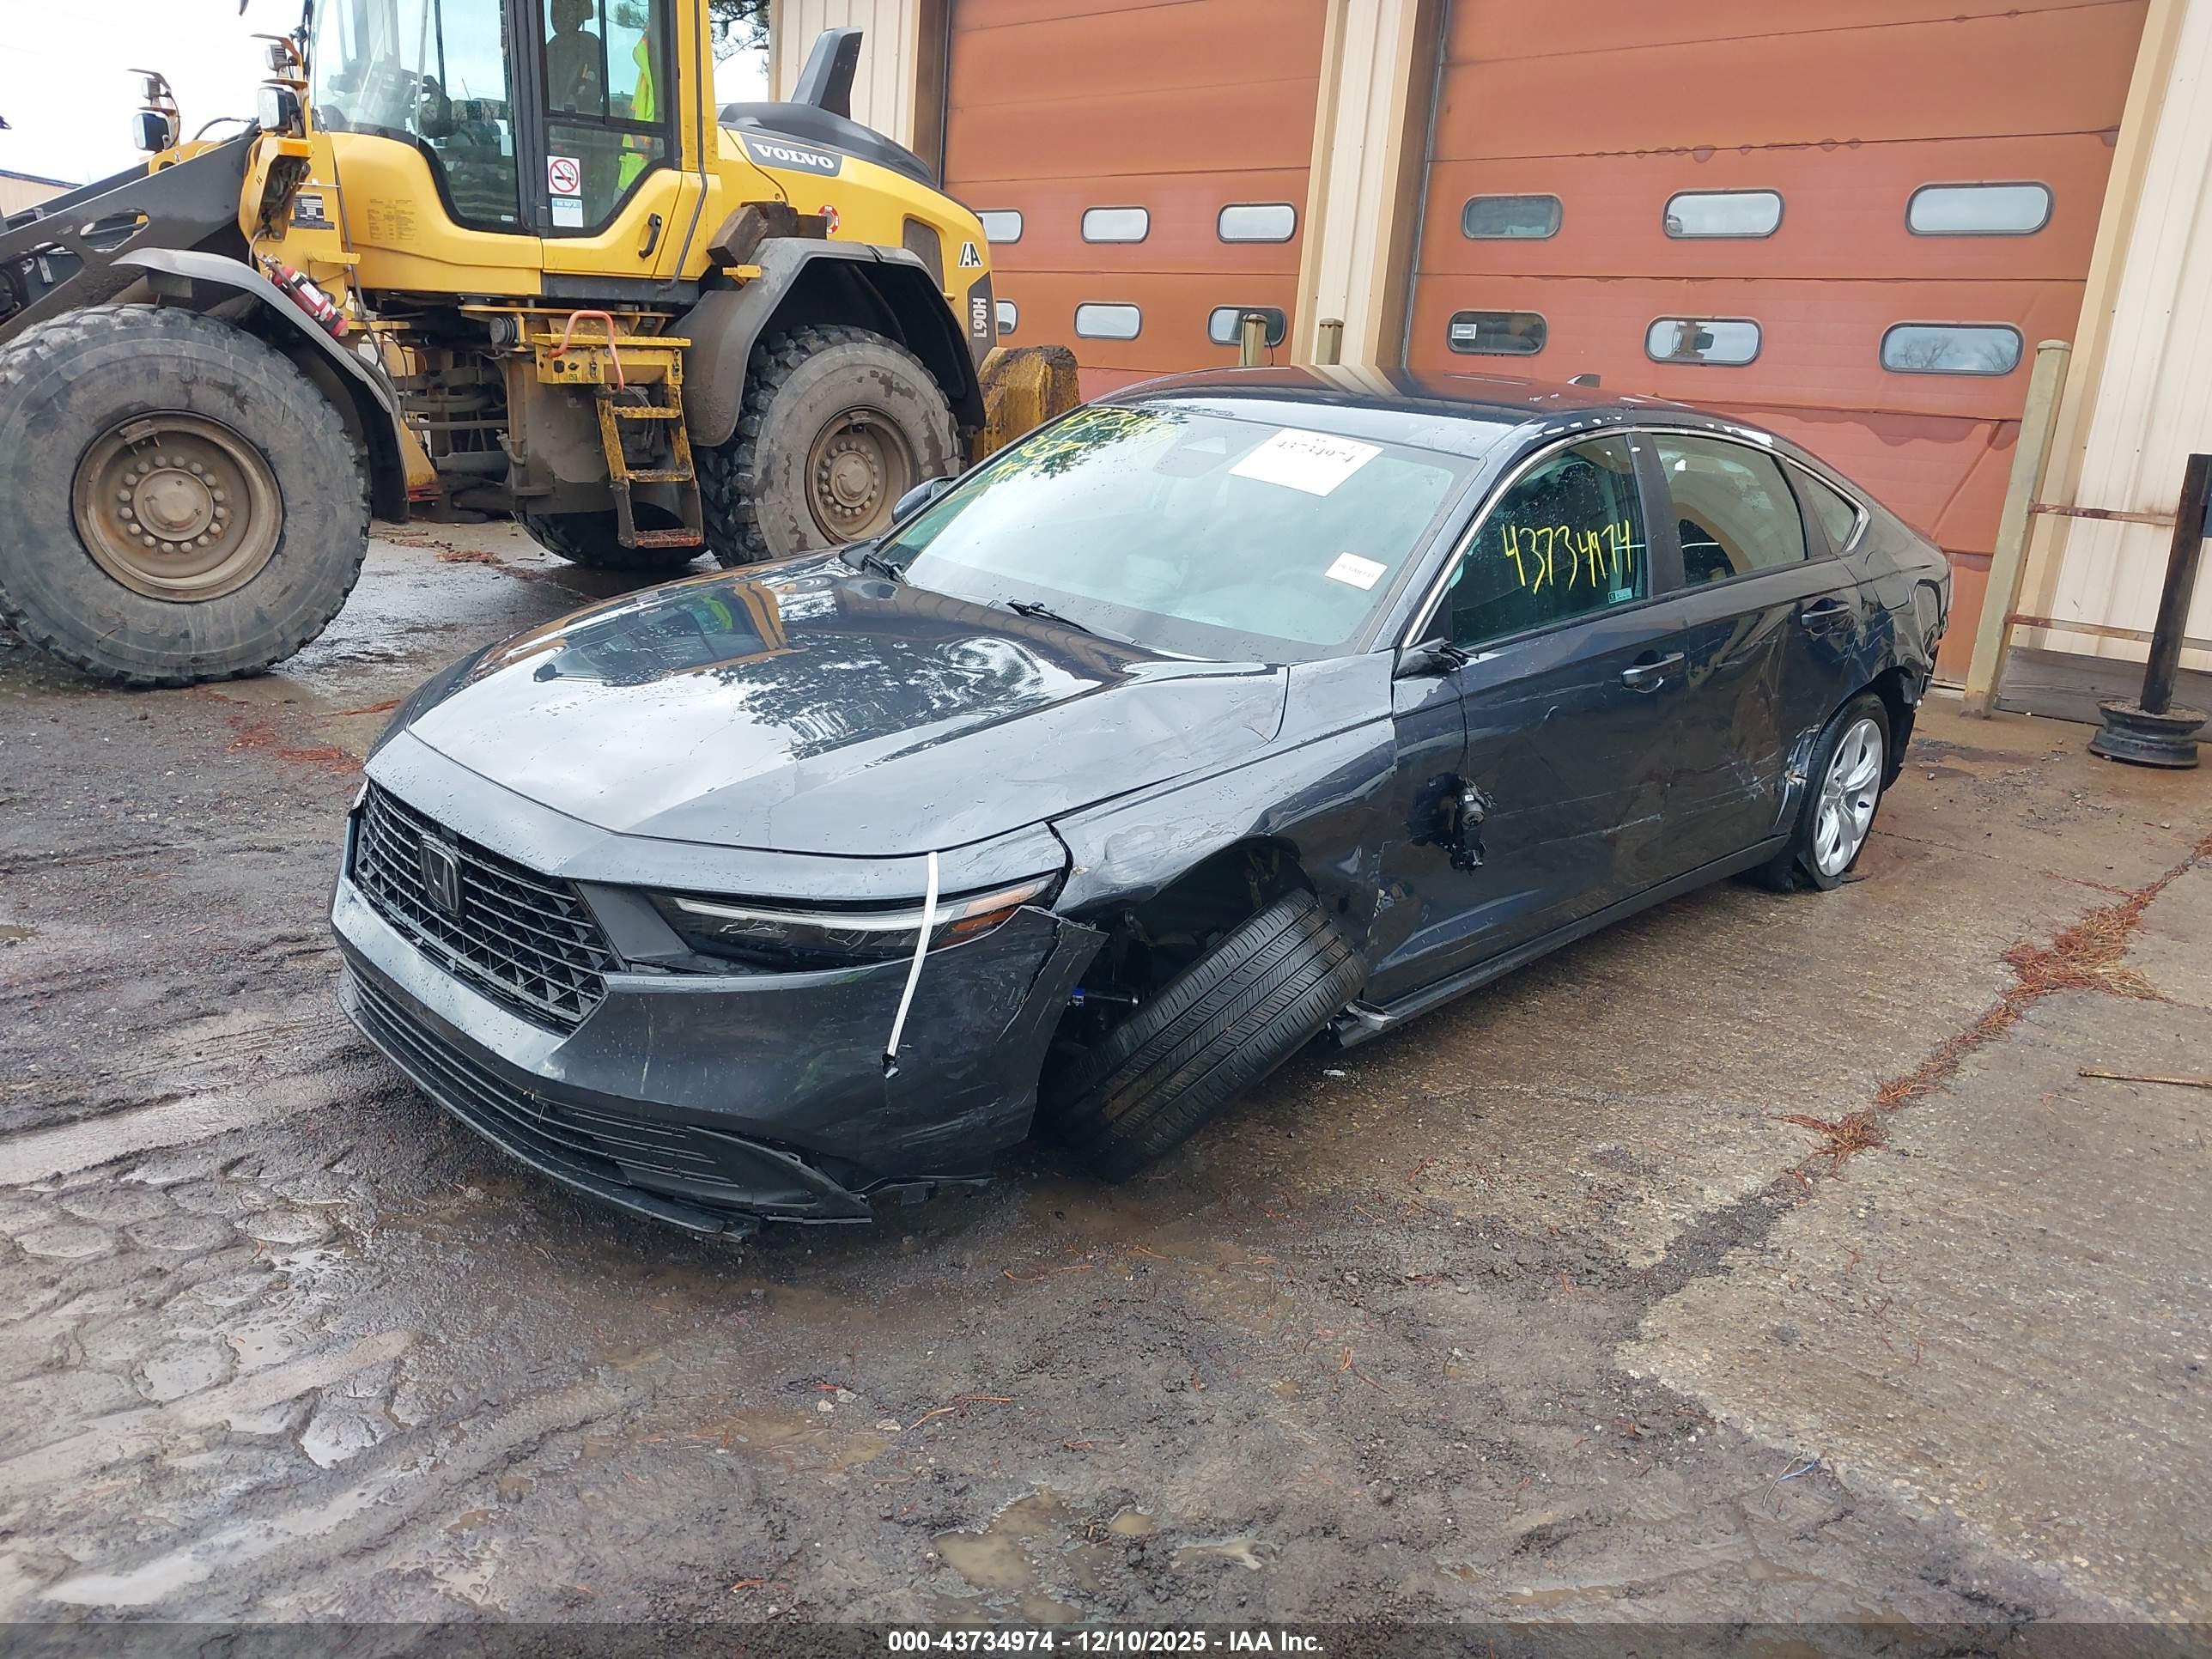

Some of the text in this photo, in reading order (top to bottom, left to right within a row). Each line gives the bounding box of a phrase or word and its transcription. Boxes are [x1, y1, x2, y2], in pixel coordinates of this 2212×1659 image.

[751, 143, 835, 169] VOLVO
[972, 297, 988, 337] L90H
[1502, 520, 1632, 595] 43734974
